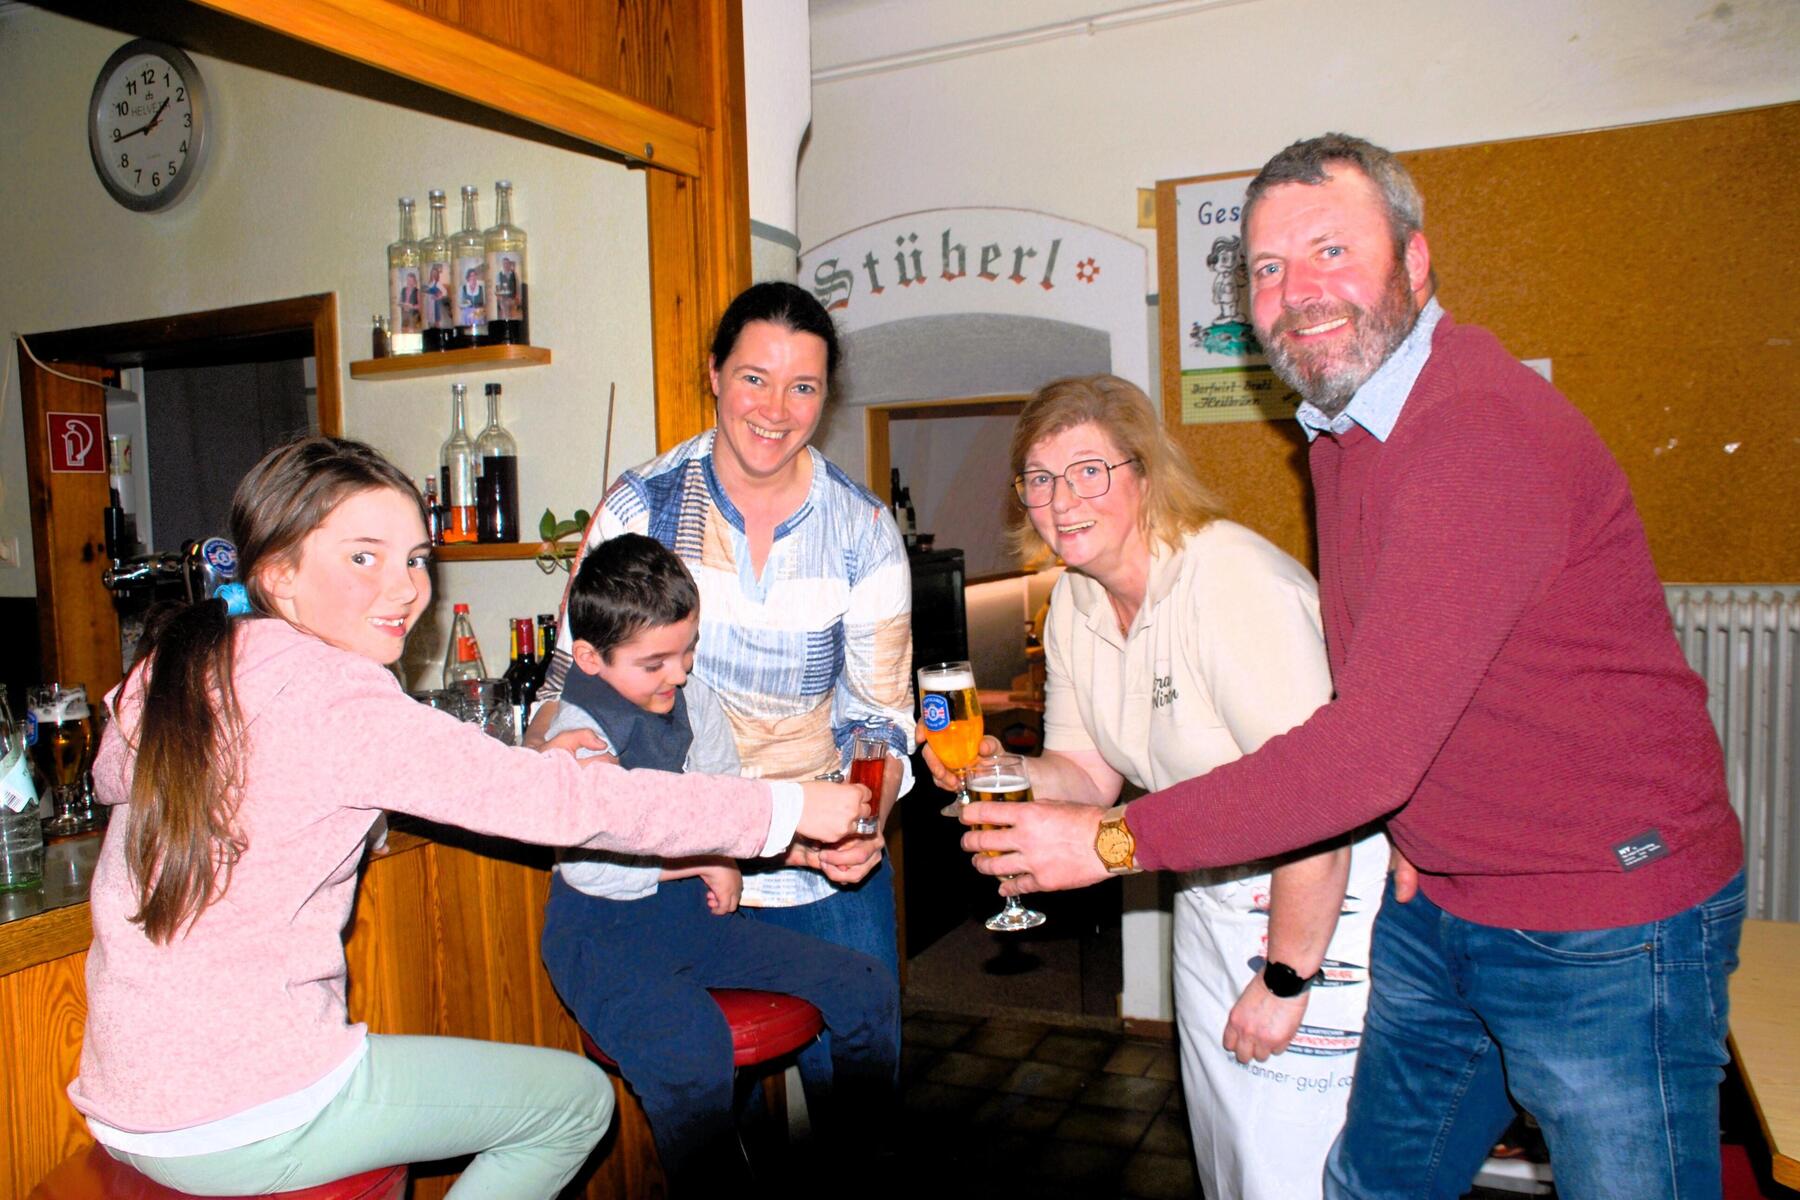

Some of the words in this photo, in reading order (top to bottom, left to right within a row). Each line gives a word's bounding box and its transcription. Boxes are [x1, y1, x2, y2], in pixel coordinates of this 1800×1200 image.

[141, 69, 155, 85] 12
[163, 72, 170, 88] 1
[126, 80, 137, 96] 11
[175, 87, 185, 103] 2
[115, 101, 129, 117] 10
[184, 113, 192, 128] 3
[113, 128, 122, 141] 9
[179, 139, 187, 155] 4
[120, 154, 129, 168] 8
[168, 161, 177, 176] 5
[134, 169, 142, 185] 7
[152, 172, 160, 187] 6
[1198, 201, 1241, 226] Ges
[813, 227, 1062, 312] Stüberl
